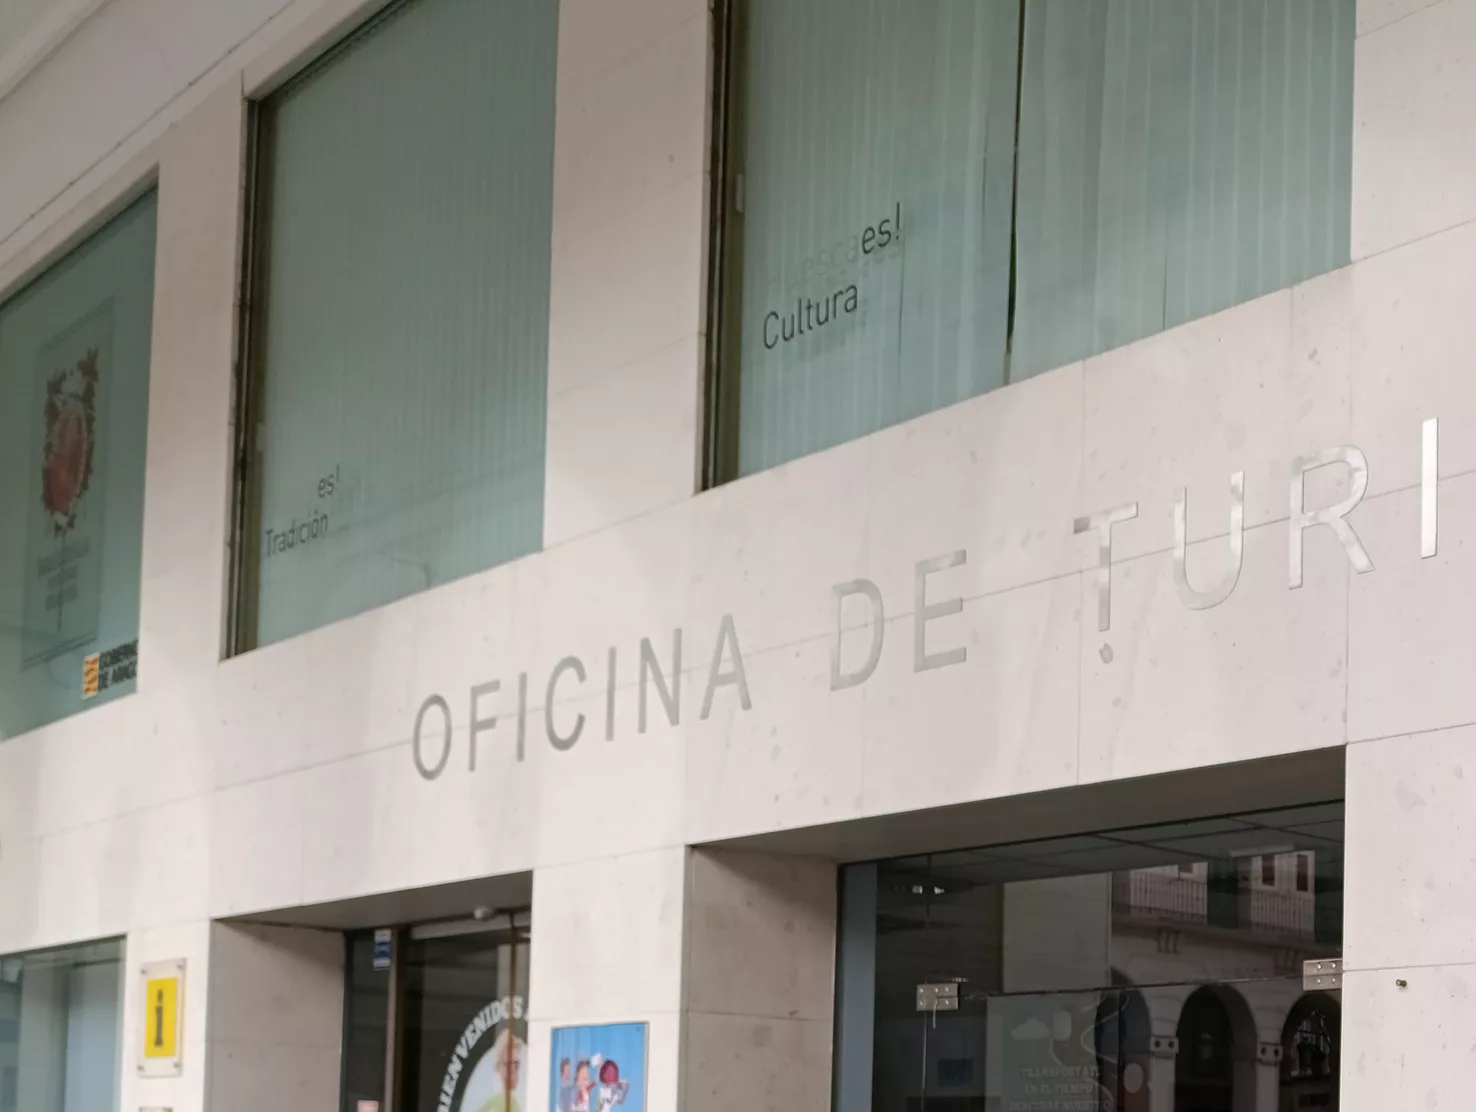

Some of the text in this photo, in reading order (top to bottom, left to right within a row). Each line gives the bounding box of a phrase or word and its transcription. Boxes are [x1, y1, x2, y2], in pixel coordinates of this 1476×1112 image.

[861, 201, 901, 255] es!
[762, 284, 858, 350] Cultura
[412, 613, 753, 782] OFICINA
[830, 548, 967, 692] DE
